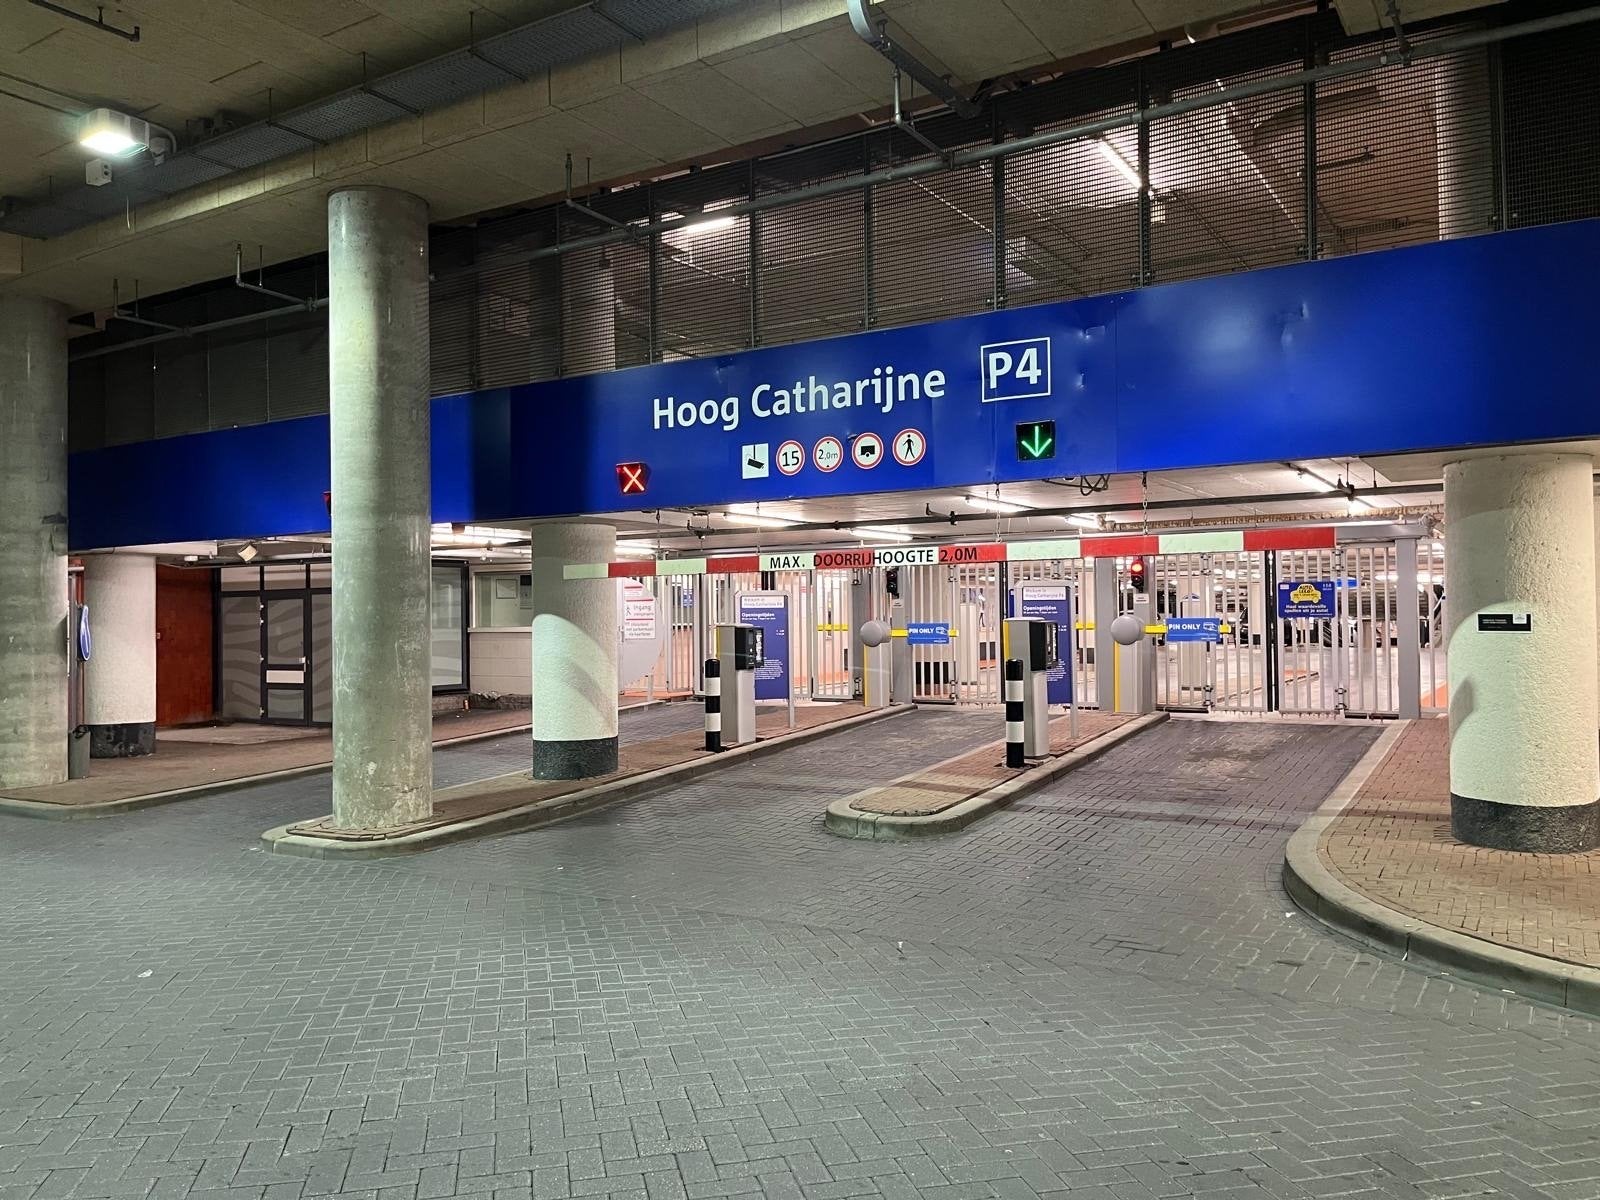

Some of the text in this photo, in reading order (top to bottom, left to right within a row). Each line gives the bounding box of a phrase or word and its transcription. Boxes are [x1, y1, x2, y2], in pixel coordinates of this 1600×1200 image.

[988, 347, 1042, 389] P4
[653, 365, 946, 431] Hoog Catharijne
[782, 450, 800, 467] 15
[769, 547, 977, 569] MAX. DOORRIJHOOGTE 2,0M
